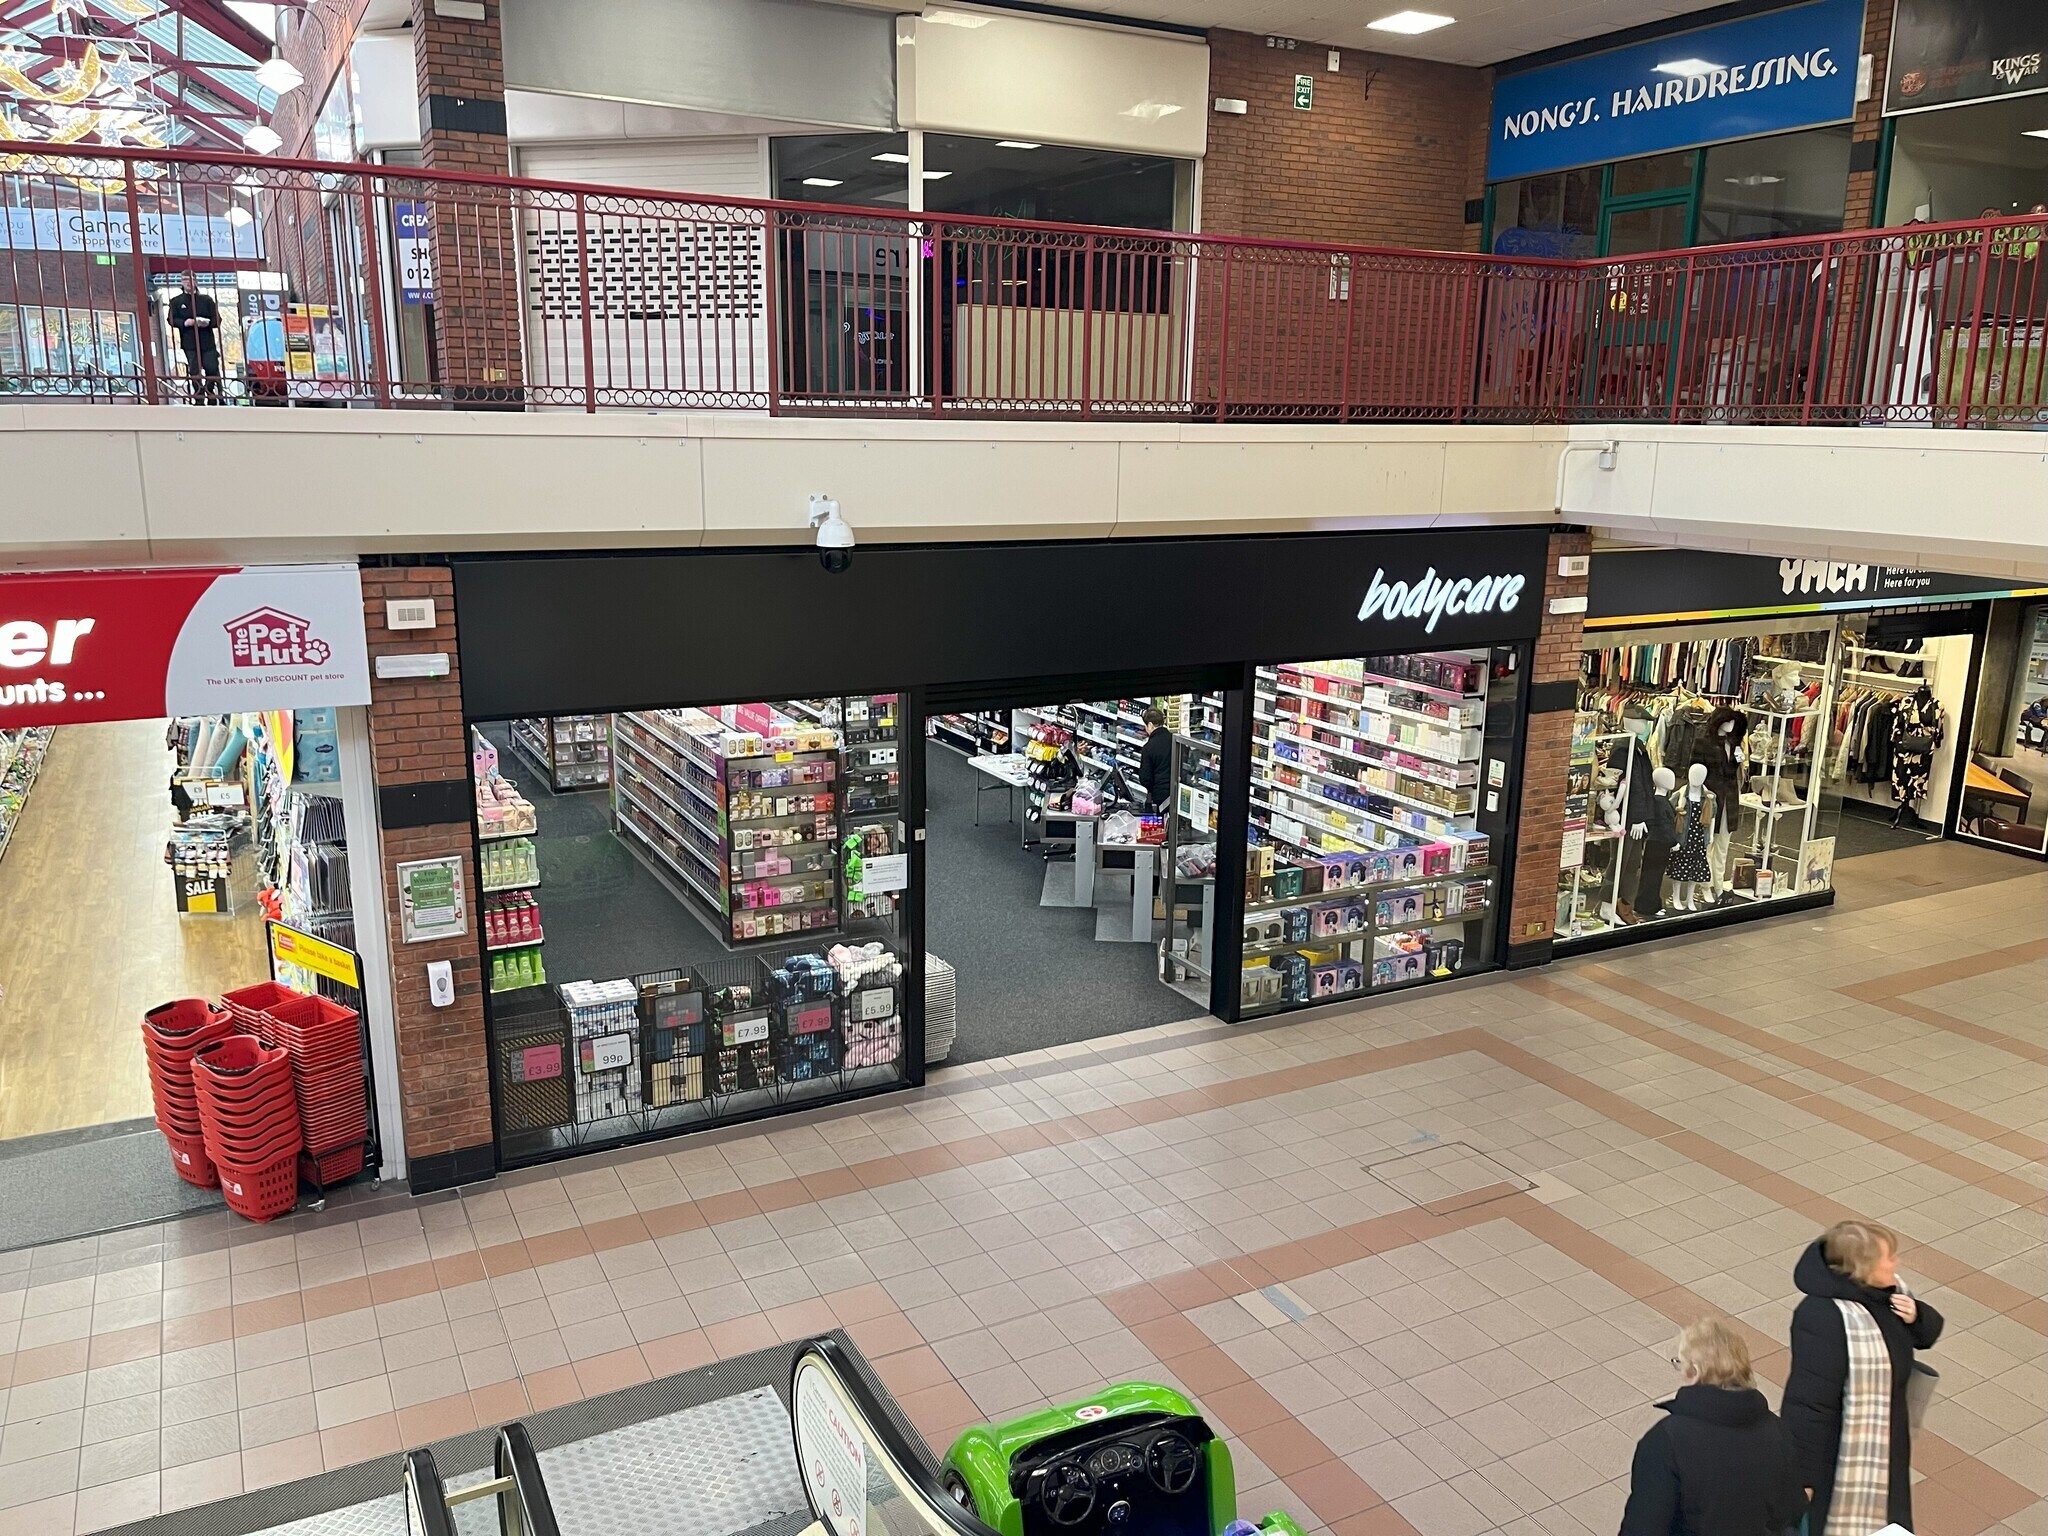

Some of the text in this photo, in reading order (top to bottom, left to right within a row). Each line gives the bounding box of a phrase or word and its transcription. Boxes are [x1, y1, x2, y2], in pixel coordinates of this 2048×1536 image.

[1991, 52, 2042, 76] KINGS
[1297, 78, 1311, 87] FIRE
[1610, 47, 1838, 117] HAIRDRESSING.
[2003, 66, 2040, 86] WAR
[1296, 86, 1311, 94] EXIT
[71, 235, 122, 249] Shoppng
[1779, 557, 1869, 596] YMCA
[1884, 576, 1931, 589] Here for you
[1357, 566, 1526, 634] bodycare
[0, 617, 96, 668] er
[233, 628, 249, 657] the
[248, 623, 301, 645] Pet
[251, 643, 304, 665] Hut
[207, 678, 222, 686] The
[245, 677, 262, 685] only
[265, 674, 308, 683] DISCOUNT
[310, 674, 323, 682] pet
[0, 677, 67, 706] unts
[220, 792, 231, 800] £5
[185, 879, 216, 897] SALE
[865, 1003, 892, 1016] £5.99
[738, 1025, 767, 1038] £7.99
[802, 1016, 830, 1029] £7.99
[602, 1053, 624, 1065] 99p
[528, 1062, 561, 1076] £3.99
[828, 1408, 862, 1468] CAUTION
